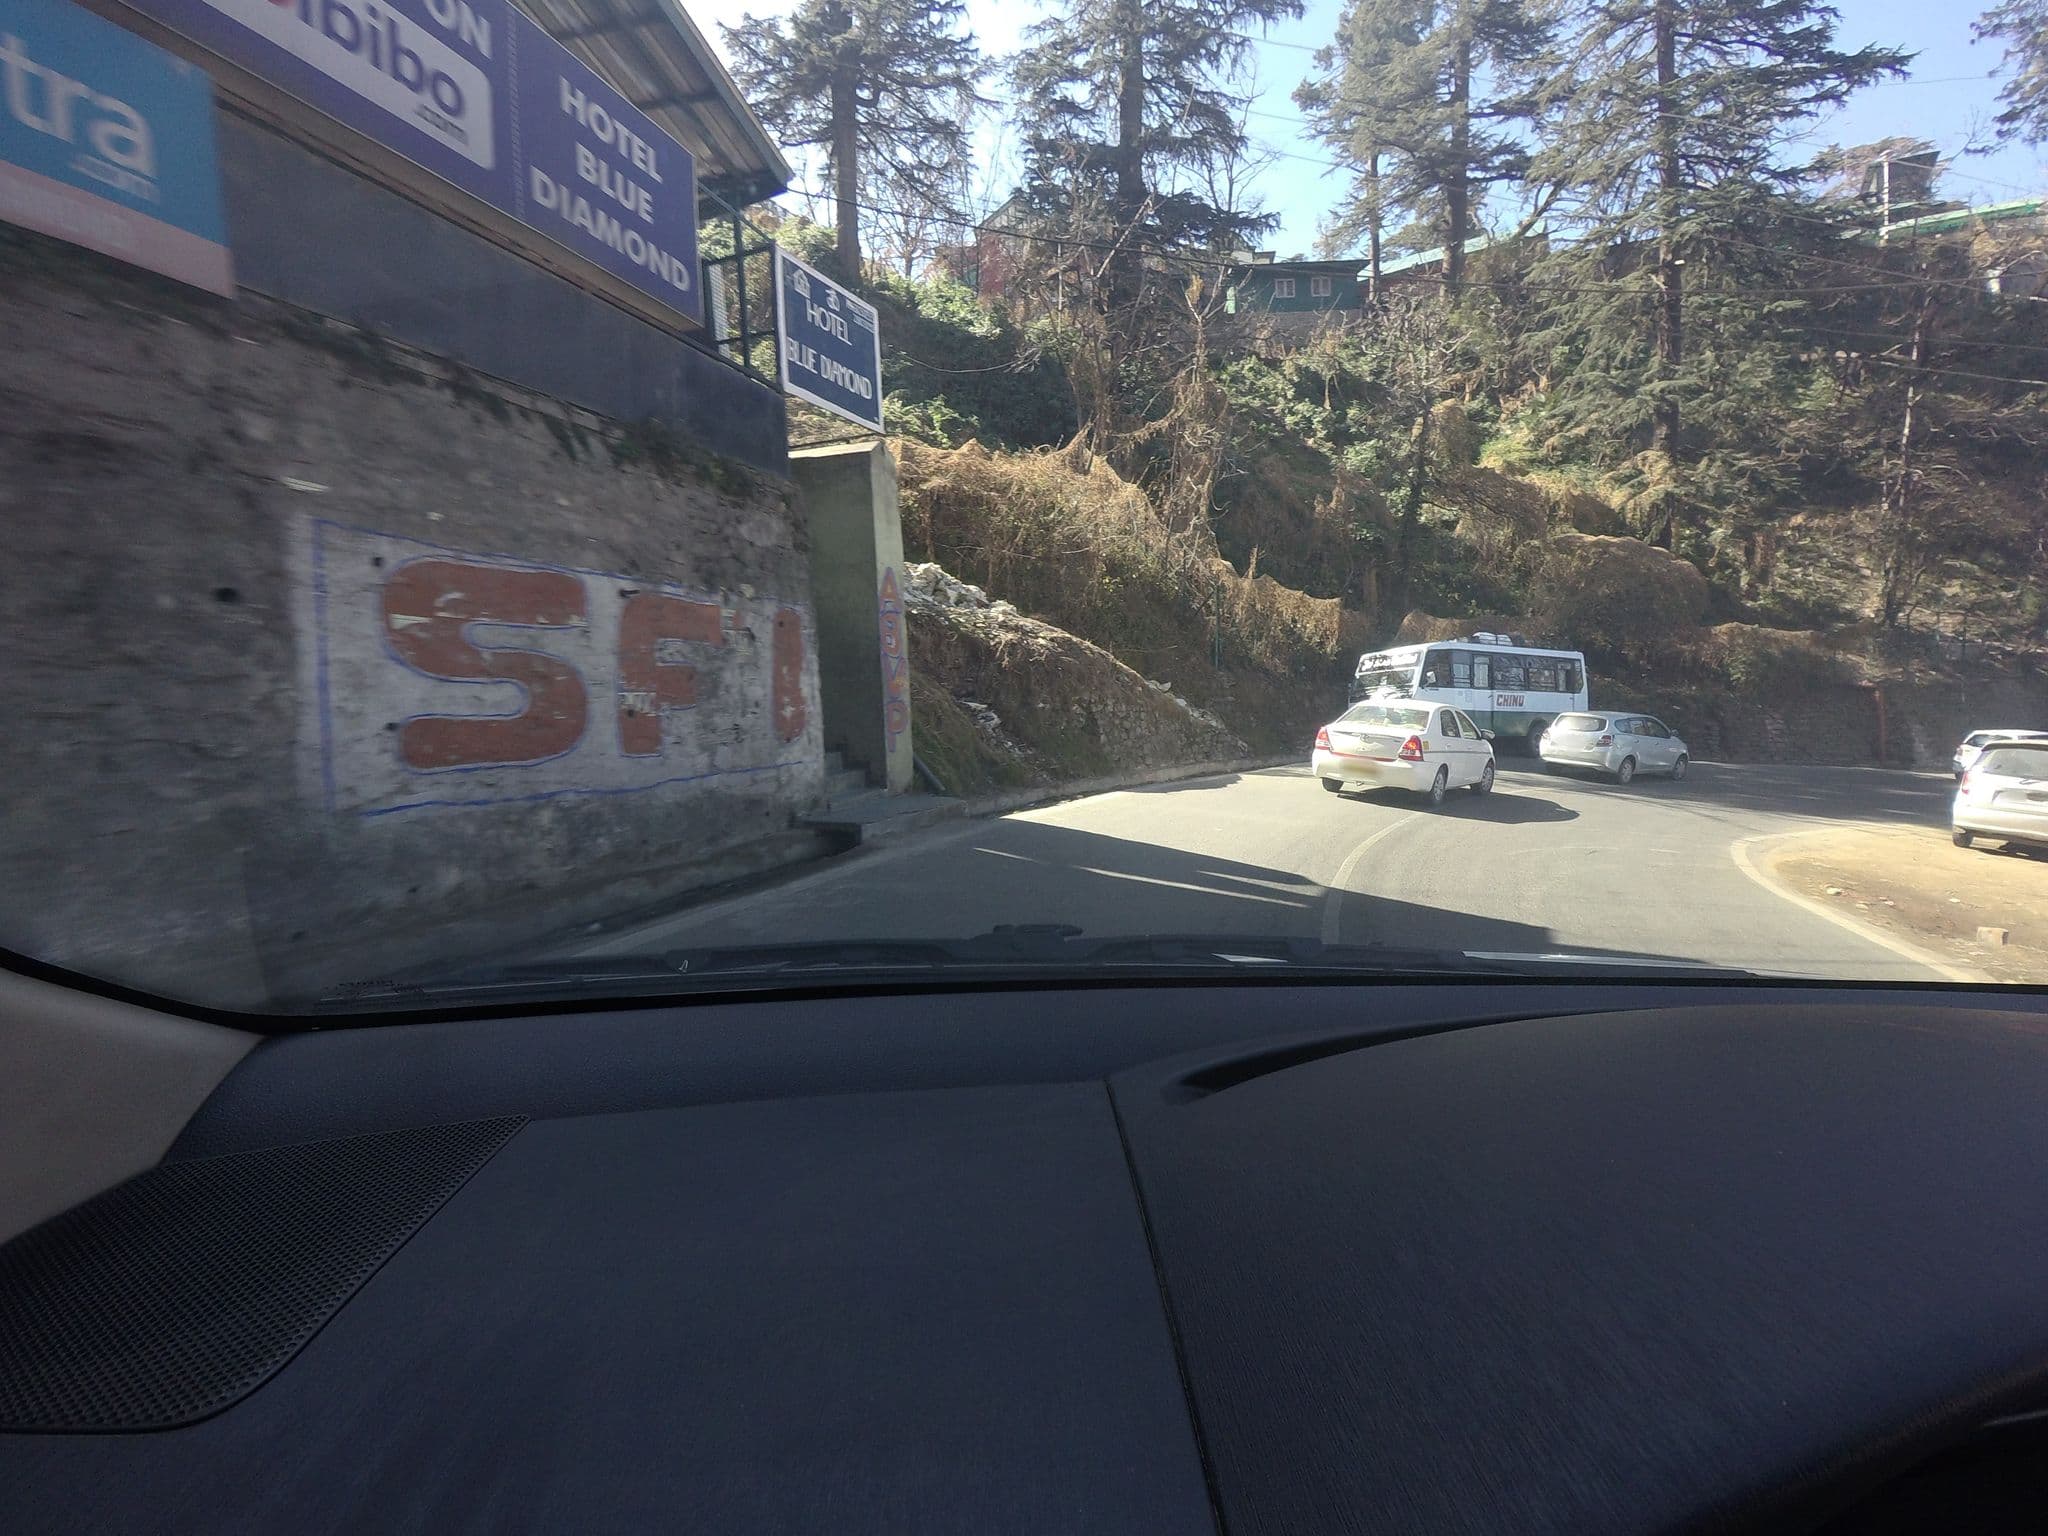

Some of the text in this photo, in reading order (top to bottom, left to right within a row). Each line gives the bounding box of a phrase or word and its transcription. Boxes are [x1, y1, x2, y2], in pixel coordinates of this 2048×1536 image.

[559, 74, 663, 185] HOTEL
[575, 141, 655, 225] BLUE
[530, 165, 691, 293] DIAMOND
[806, 299, 853, 346] HOTEL
[786, 336, 873, 400] BLUE DIAMOND
